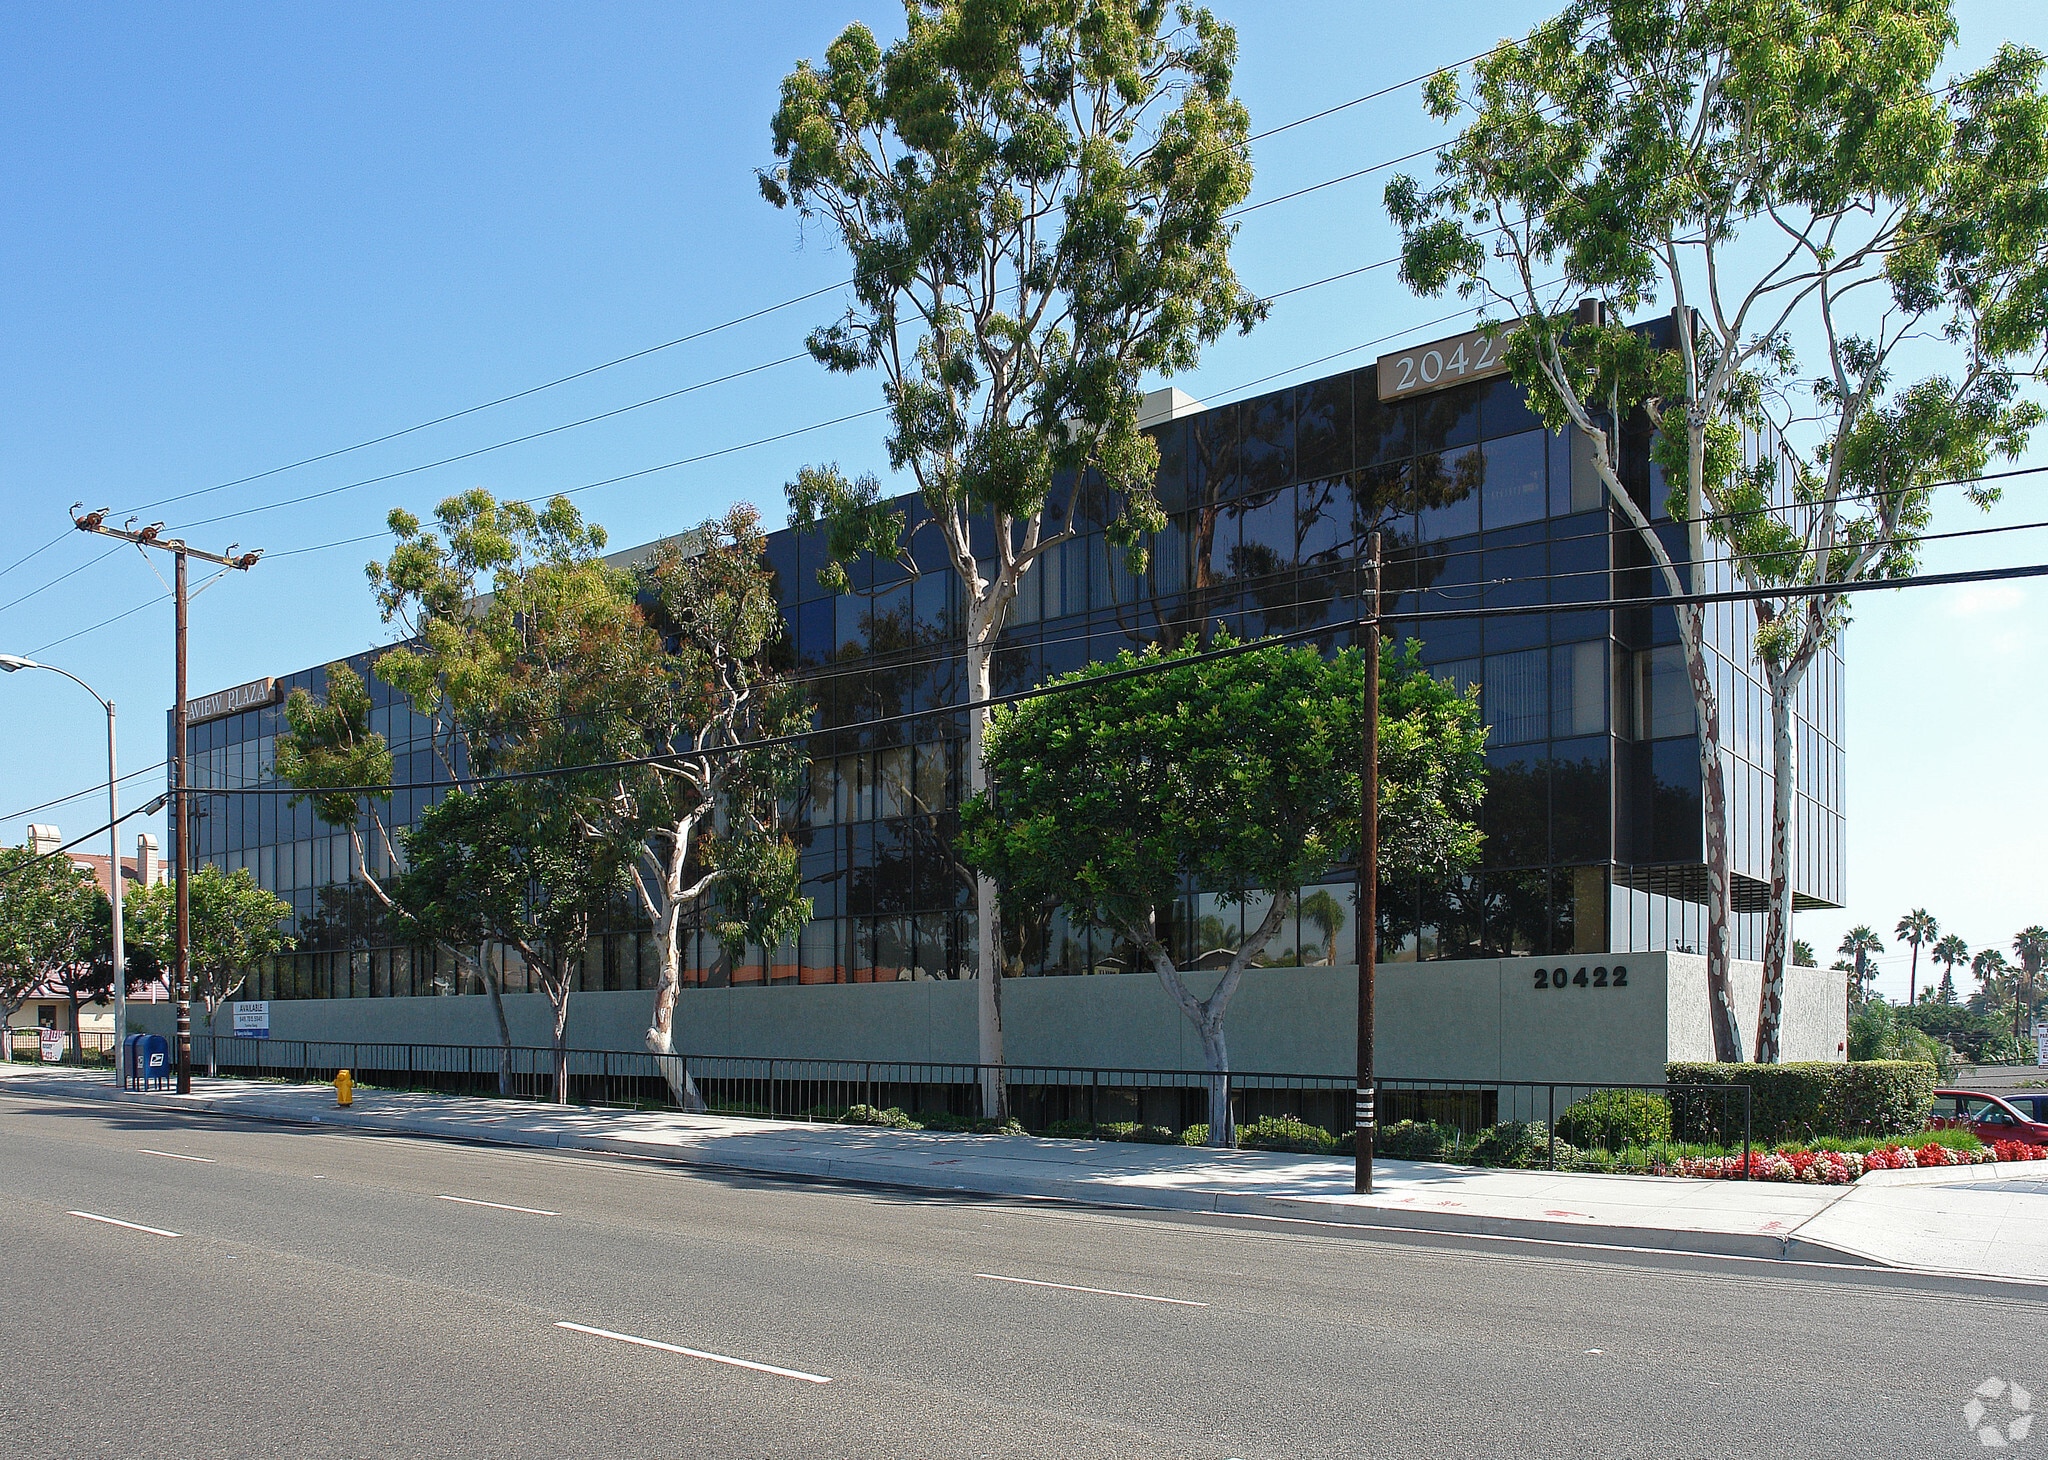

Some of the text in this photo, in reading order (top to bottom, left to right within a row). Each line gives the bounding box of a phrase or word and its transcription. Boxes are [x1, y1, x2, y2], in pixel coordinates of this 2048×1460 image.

[187, 682, 266, 720] AVIEW PLAZA
[1534, 965, 1628, 989] 20422
[239, 1003, 263, 1013] AVAILABLE
